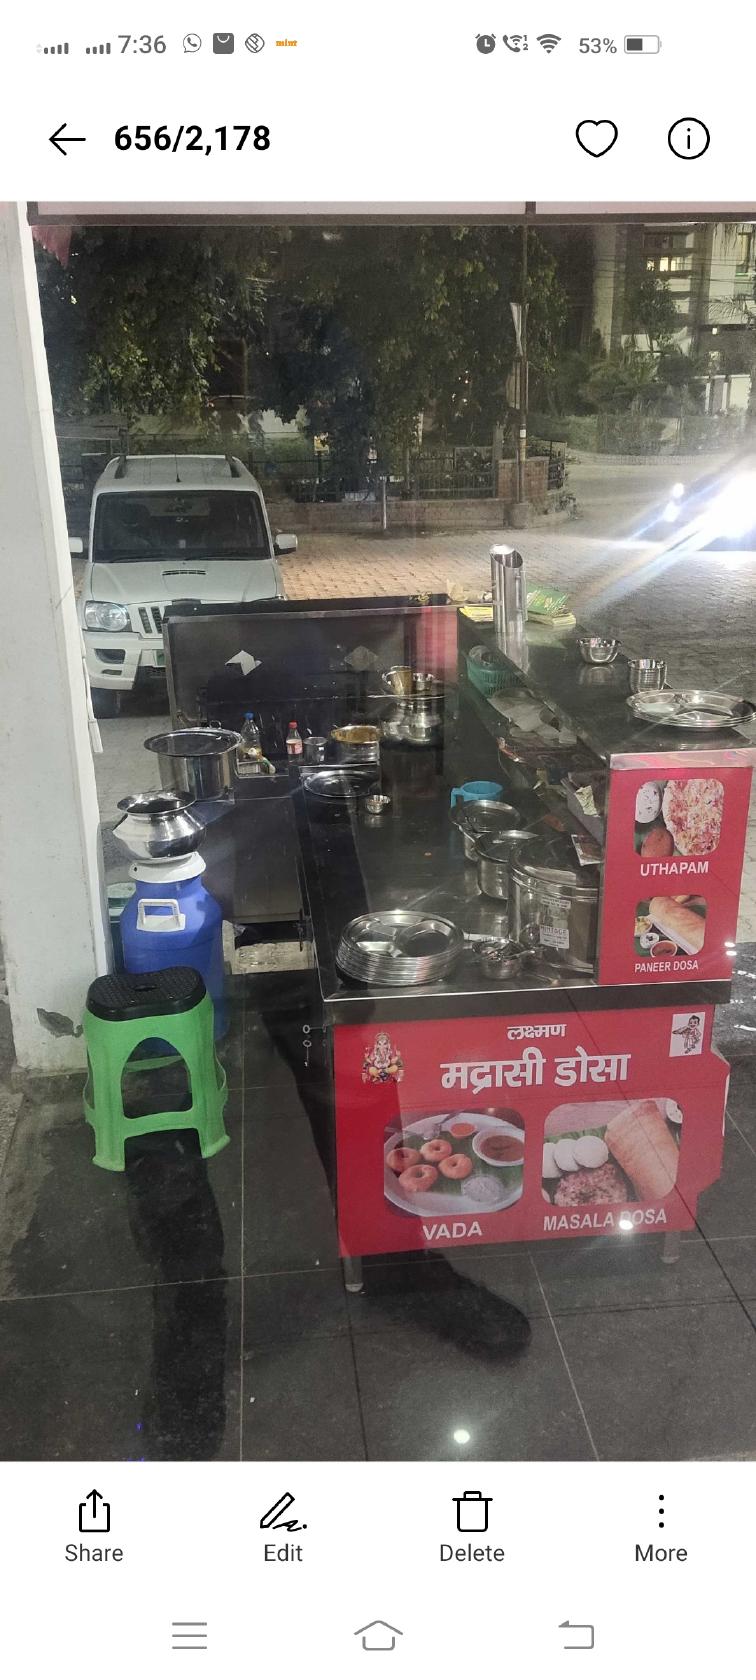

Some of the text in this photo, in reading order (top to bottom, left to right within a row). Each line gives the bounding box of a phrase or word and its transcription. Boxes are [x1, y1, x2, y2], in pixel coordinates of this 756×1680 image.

[640, 861, 708, 877] UTHAPAM
[634, 960, 699, 973] PANEER DOSA
[507, 1023, 567, 1040] लक्ष्मण
[440, 1045, 631, 1095] मद्रासी डोसा
[543, 1211, 614, 1231] MASALA
[422, 1221, 483, 1240] VADA
